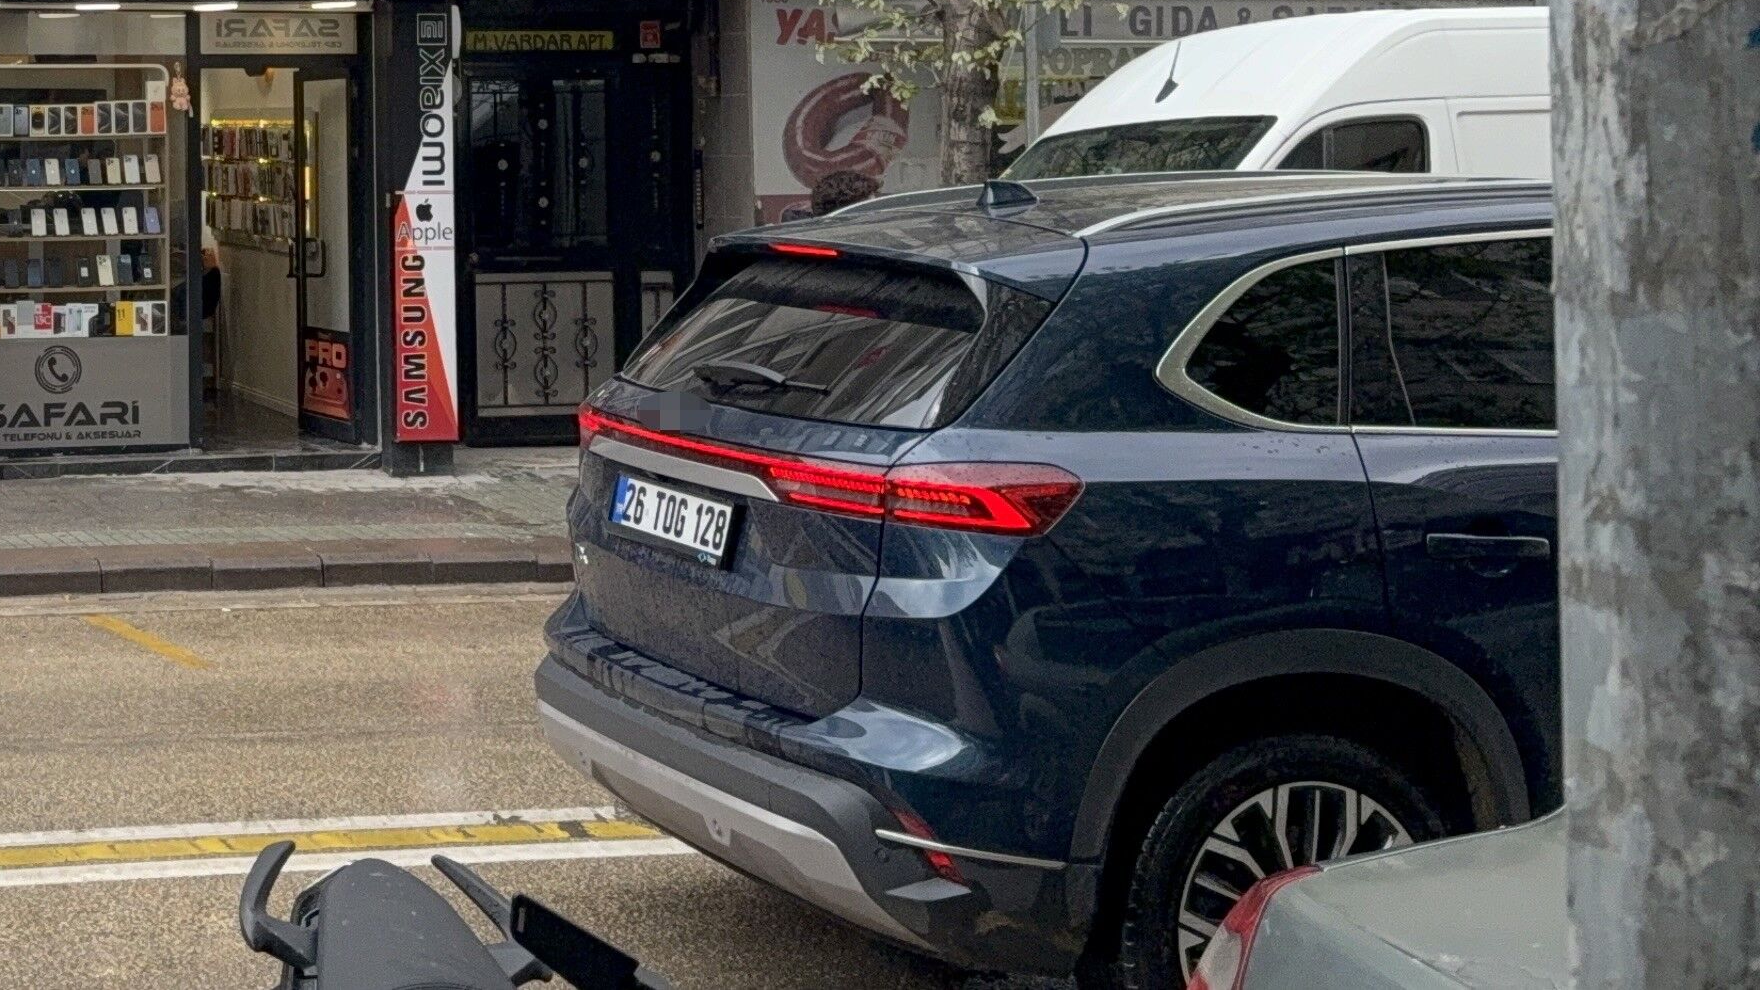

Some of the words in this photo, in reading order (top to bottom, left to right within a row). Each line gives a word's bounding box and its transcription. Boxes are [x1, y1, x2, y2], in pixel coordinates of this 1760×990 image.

[1128, 4, 1218, 37] GIDA
[397, 222, 454, 246] Apple
[401, 254, 428, 430] SAMSUNG
[2, 431, 63, 442] TELEFONU
[76, 429, 142, 440] AKSESUAR
[622, 483, 647, 526] 26
[653, 490, 689, 539] TOG
[693, 503, 727, 551] 128
